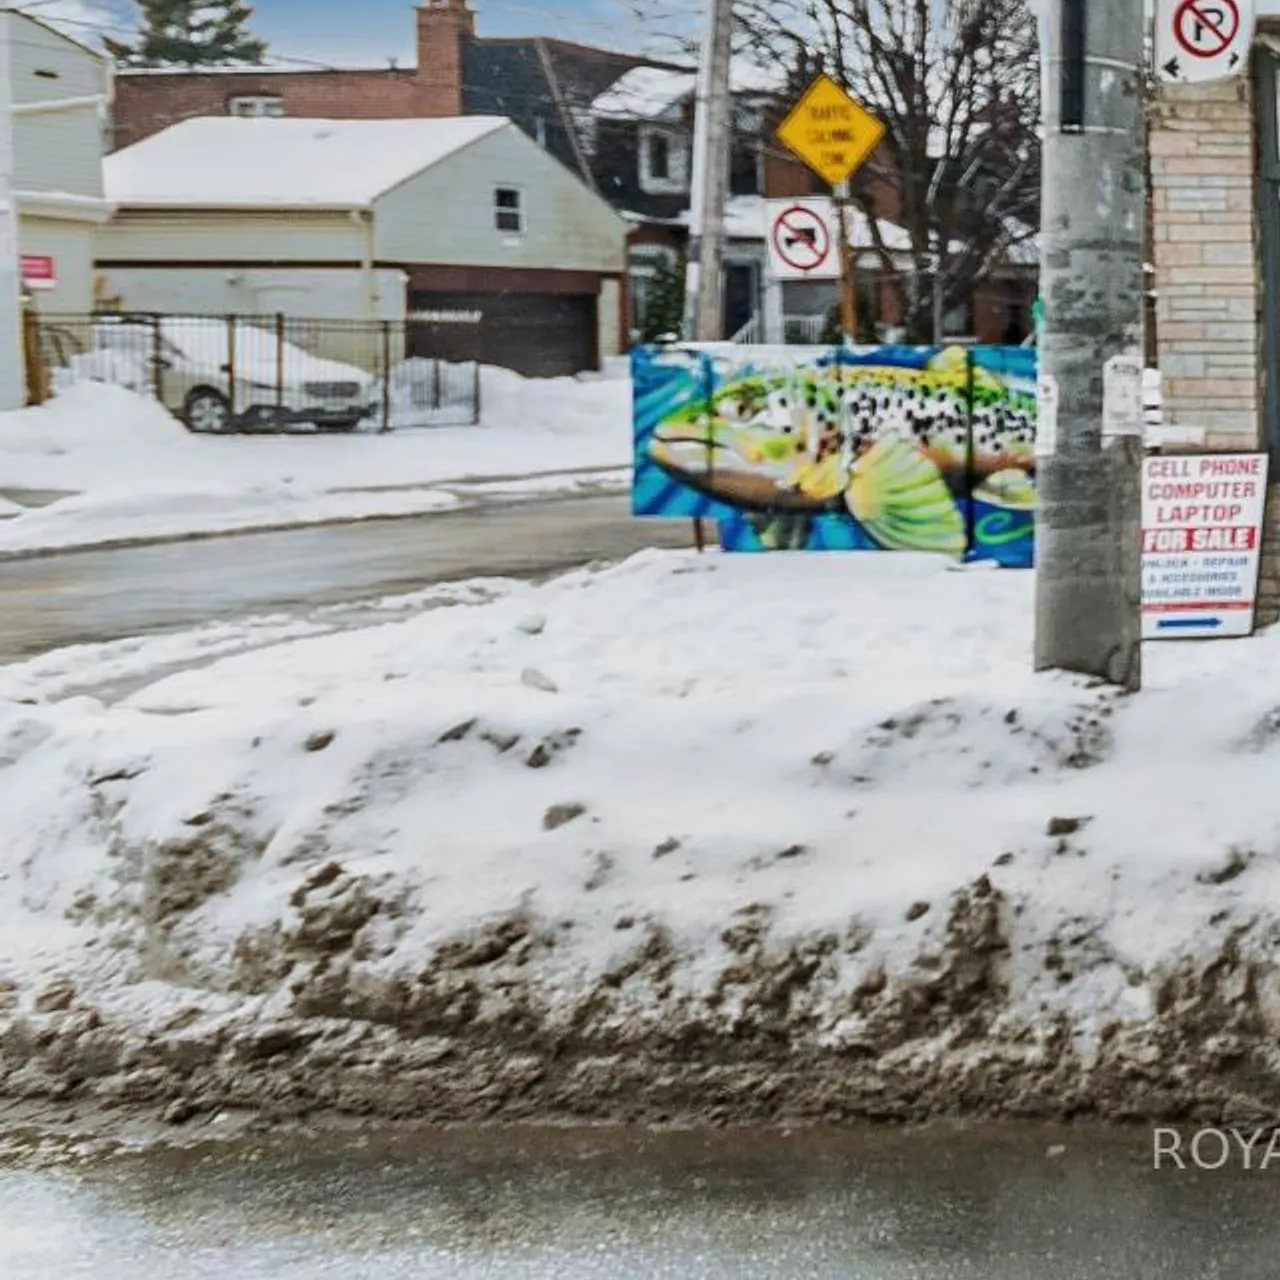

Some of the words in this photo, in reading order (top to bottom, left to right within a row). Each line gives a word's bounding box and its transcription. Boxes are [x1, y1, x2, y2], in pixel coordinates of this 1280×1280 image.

[1148, 460, 1192, 478] CELL
[1200, 458, 1262, 476] PHONE
[1148, 482, 1256, 500] COMPUTER
[1157, 504, 1242, 523] LAPTOP
[1143, 529, 1185, 552] FOR
[1194, 527, 1249, 551] SALE
